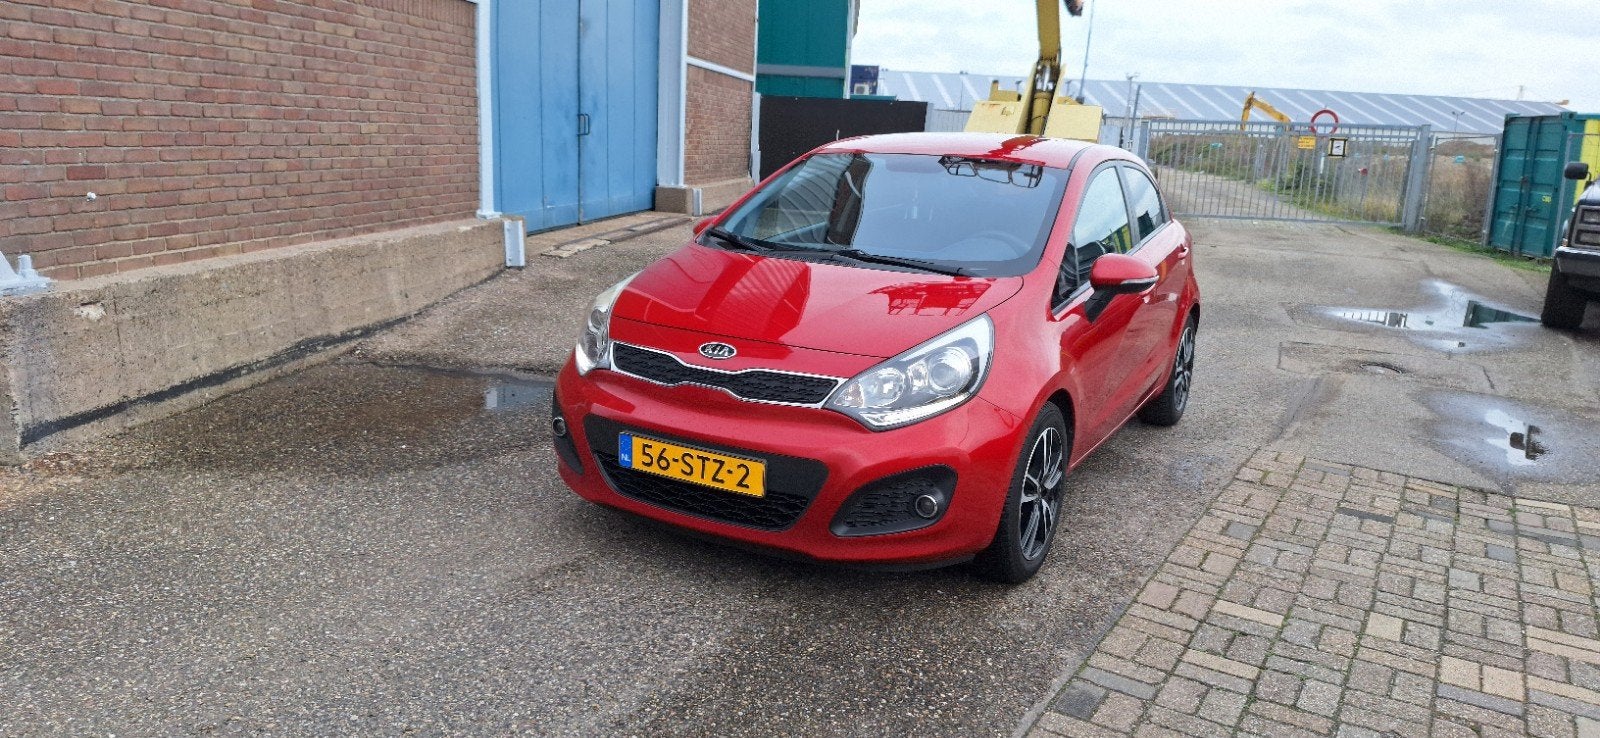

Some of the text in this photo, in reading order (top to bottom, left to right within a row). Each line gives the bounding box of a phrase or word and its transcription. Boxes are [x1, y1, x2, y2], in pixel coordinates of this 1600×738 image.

[704, 344, 729, 357] KIA
[621, 453, 631, 462] NL
[641, 443, 750, 489] 56-STZ-2
